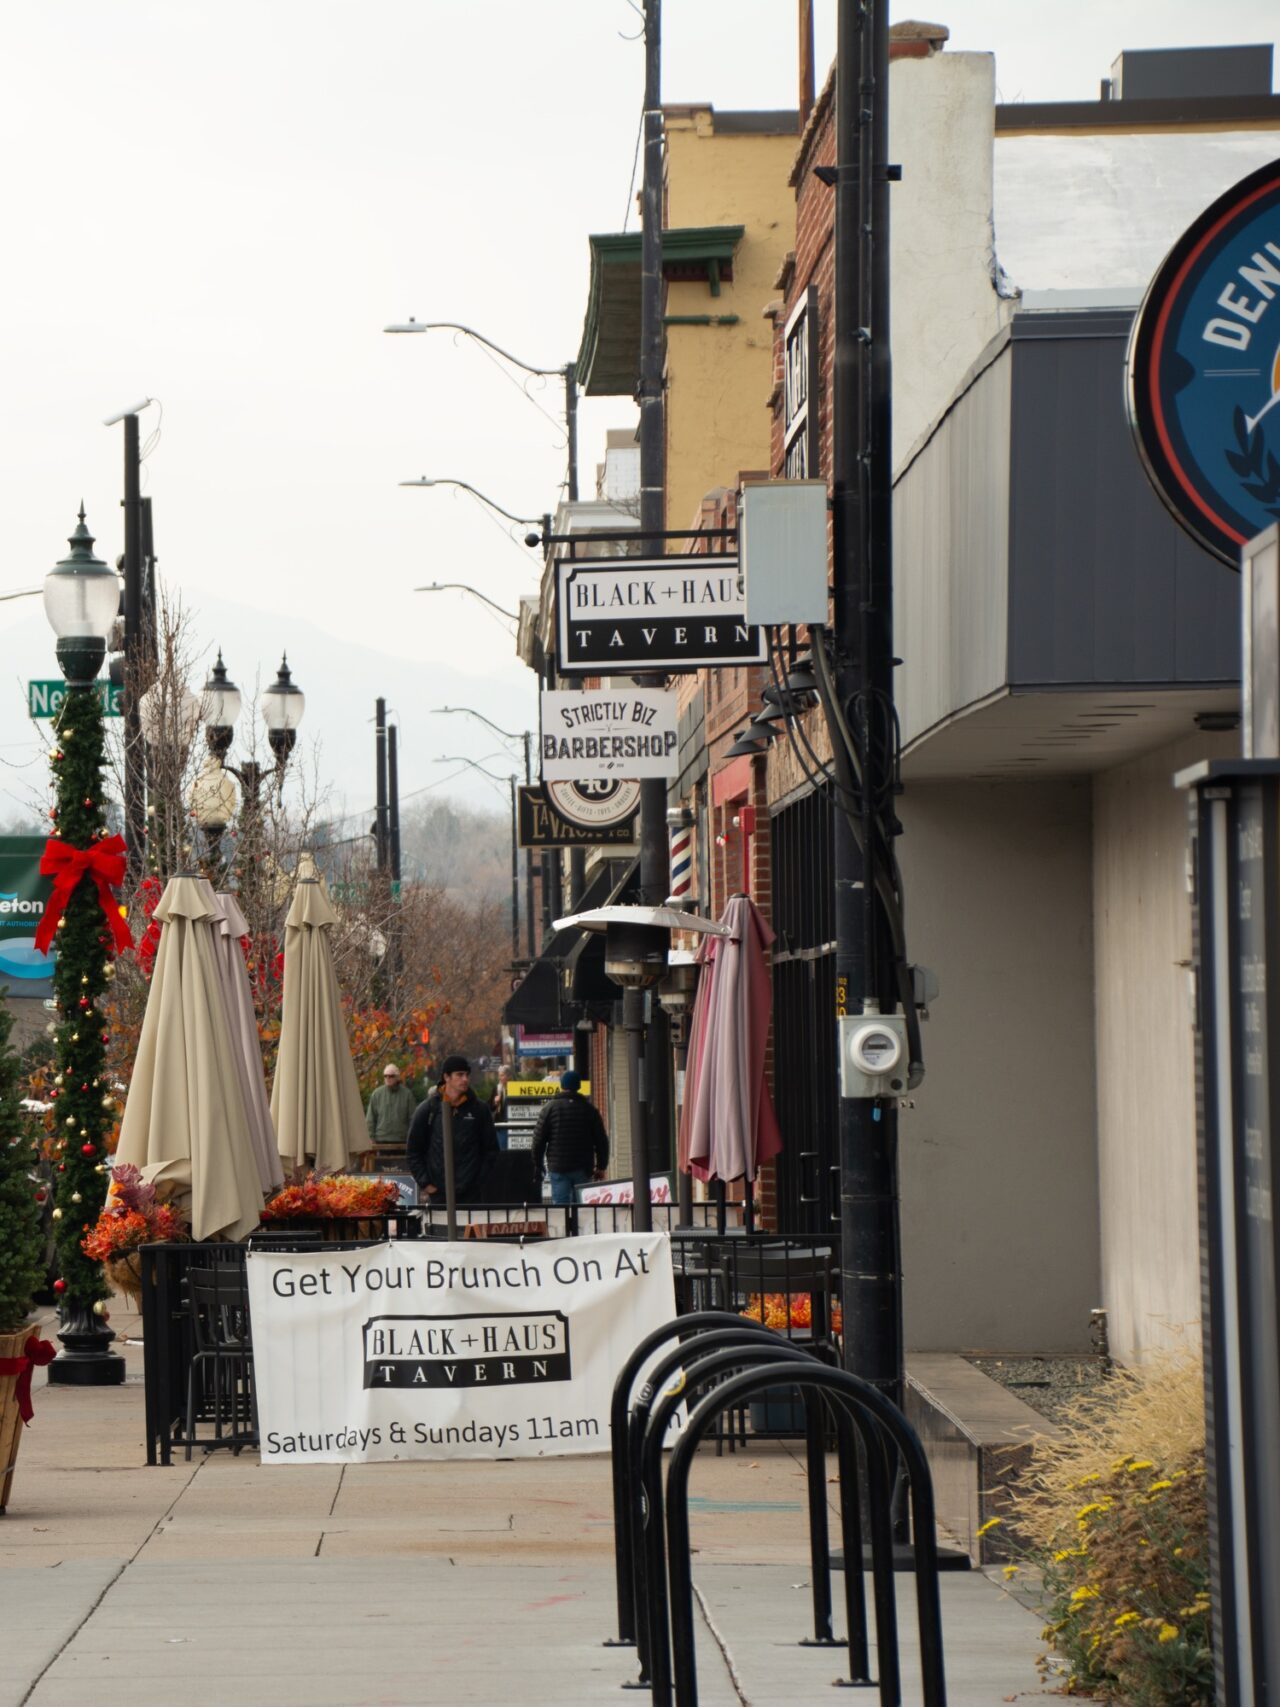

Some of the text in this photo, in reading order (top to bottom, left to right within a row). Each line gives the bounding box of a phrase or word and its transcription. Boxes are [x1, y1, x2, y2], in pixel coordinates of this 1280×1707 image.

[576, 625, 750, 648] TAVERN
[560, 700, 658, 729] STRICTLY BIZ
[543, 730, 677, 760] BARBERSHOP
[272, 1247, 650, 1297] Get Your Brunch On At
[380, 1360, 548, 1383] TAVERN
[268, 1425, 381, 1455] Saturdays
[389, 1421, 407, 1444] &
[414, 1420, 519, 1448] Sundays
[527, 1416, 599, 1440] 11am
